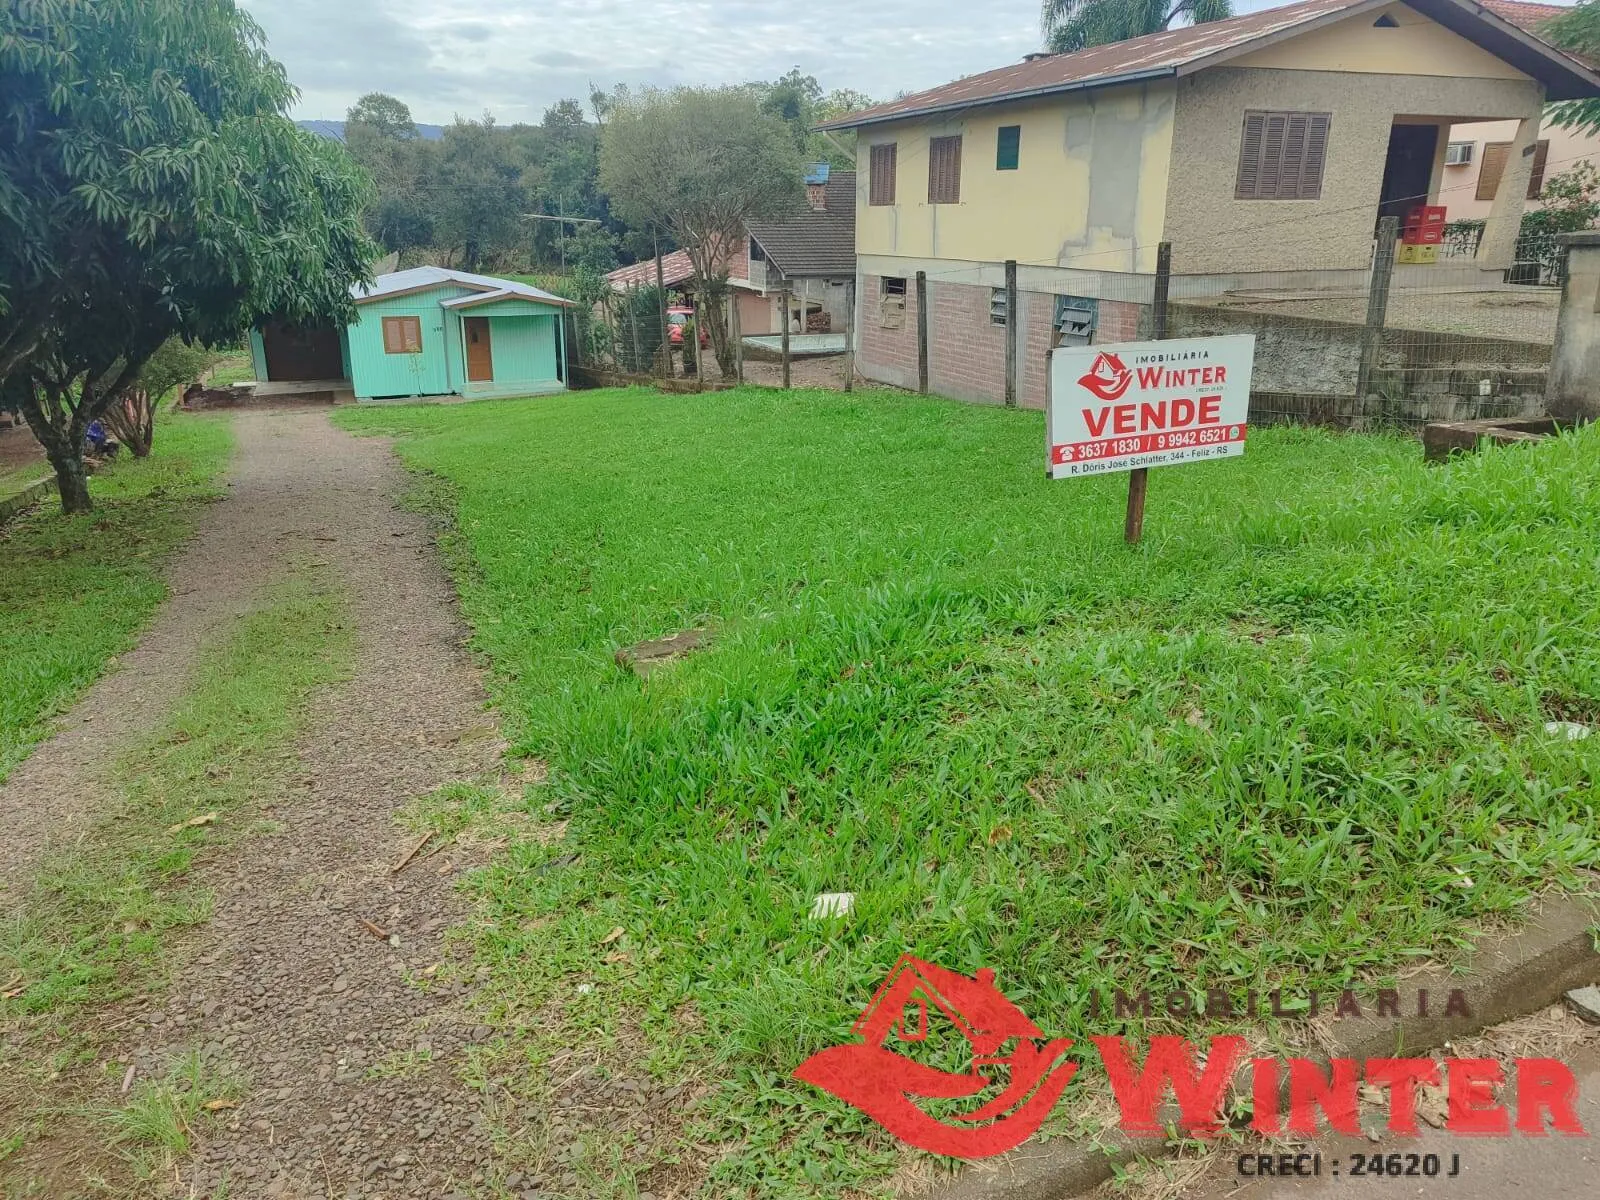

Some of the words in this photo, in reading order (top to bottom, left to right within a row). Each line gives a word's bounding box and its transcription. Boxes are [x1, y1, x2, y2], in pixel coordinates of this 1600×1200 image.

[1136, 366, 1226, 390] WINTER
[1082, 395, 1222, 437] VENDE
[1078, 440, 1108, 460] 3637
[1111, 438, 1141, 454] 1830
[1146, 436, 1152, 450] /
[1158, 434, 1166, 449] 9
[1168, 431, 1197, 448] 9942
[1199, 427, 1227, 443] 6521
[1071, 464, 1080, 474] R.
[1170, 452, 1185, 461] 344
[1191, 447, 1210, 457] Feliz
[1216, 445, 1229, 454] RS
